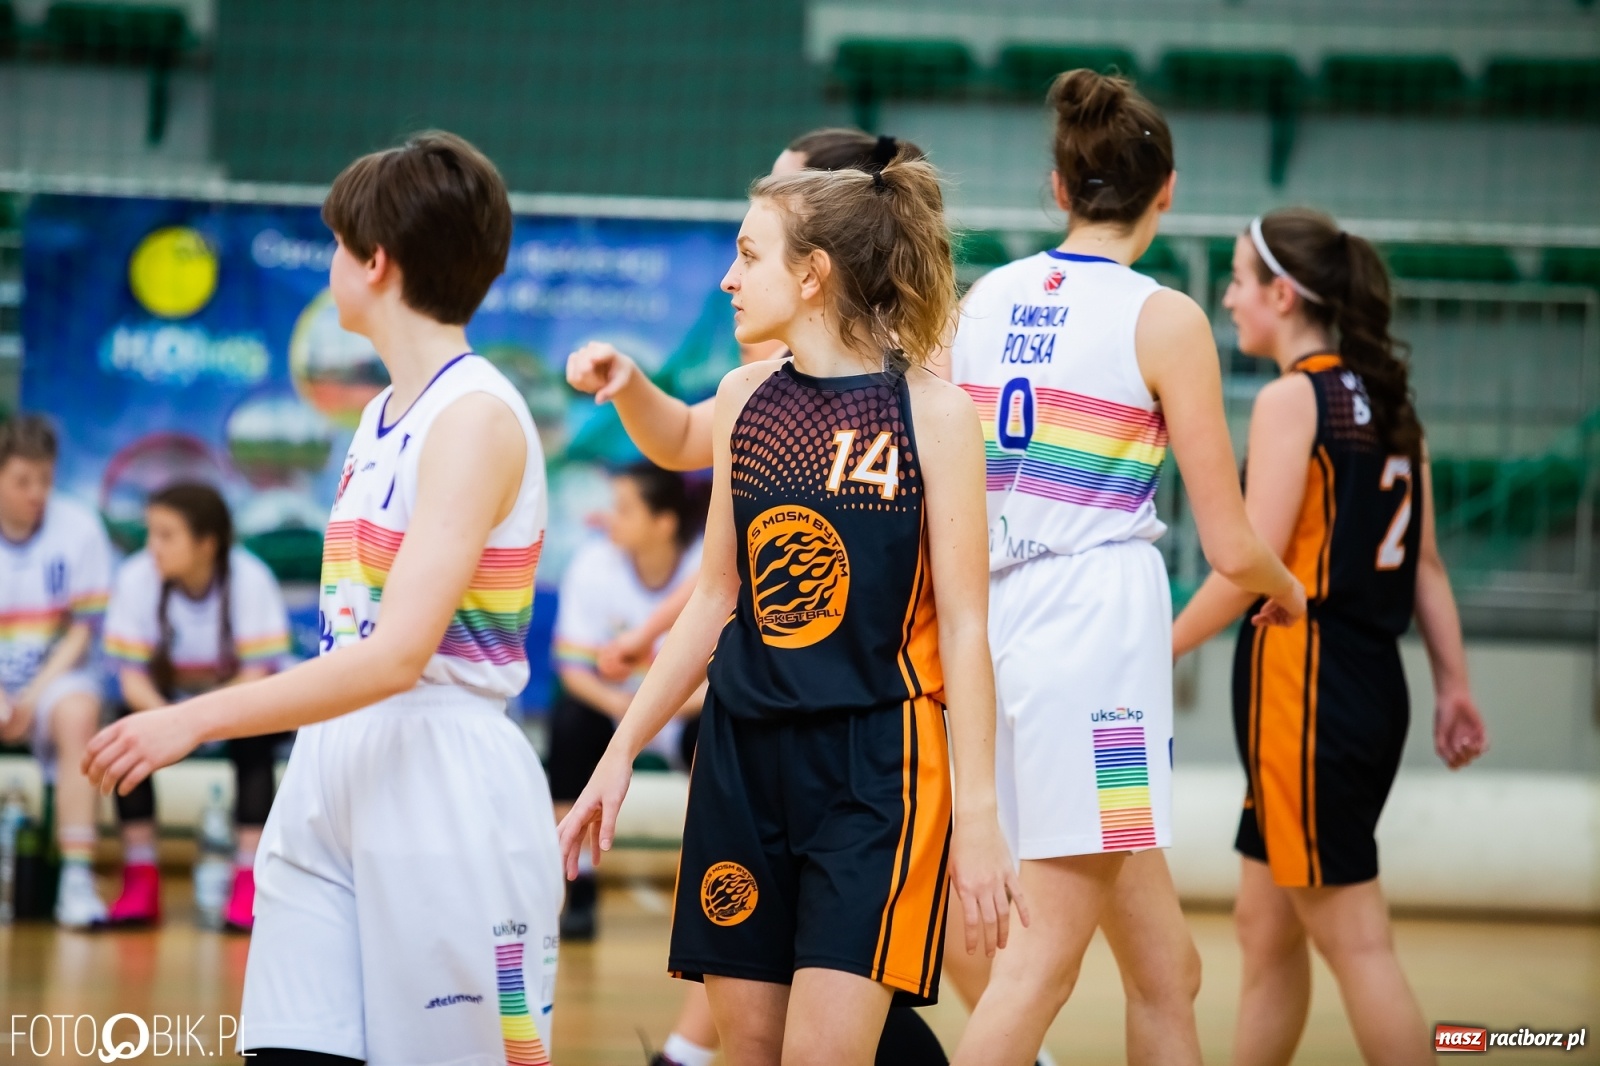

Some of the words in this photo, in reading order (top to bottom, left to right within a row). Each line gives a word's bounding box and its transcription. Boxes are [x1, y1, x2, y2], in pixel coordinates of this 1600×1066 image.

[1001, 333, 1056, 364] POLSKA
[998, 377, 1034, 450] 0
[826, 429, 899, 500] 14
[762, 511, 810, 529] MOSM
[812, 518, 848, 577] BYTOM
[1375, 455, 1413, 572] 2
[757, 609, 842, 625] ASKETBALL
[712, 864, 735, 873] MOSM
